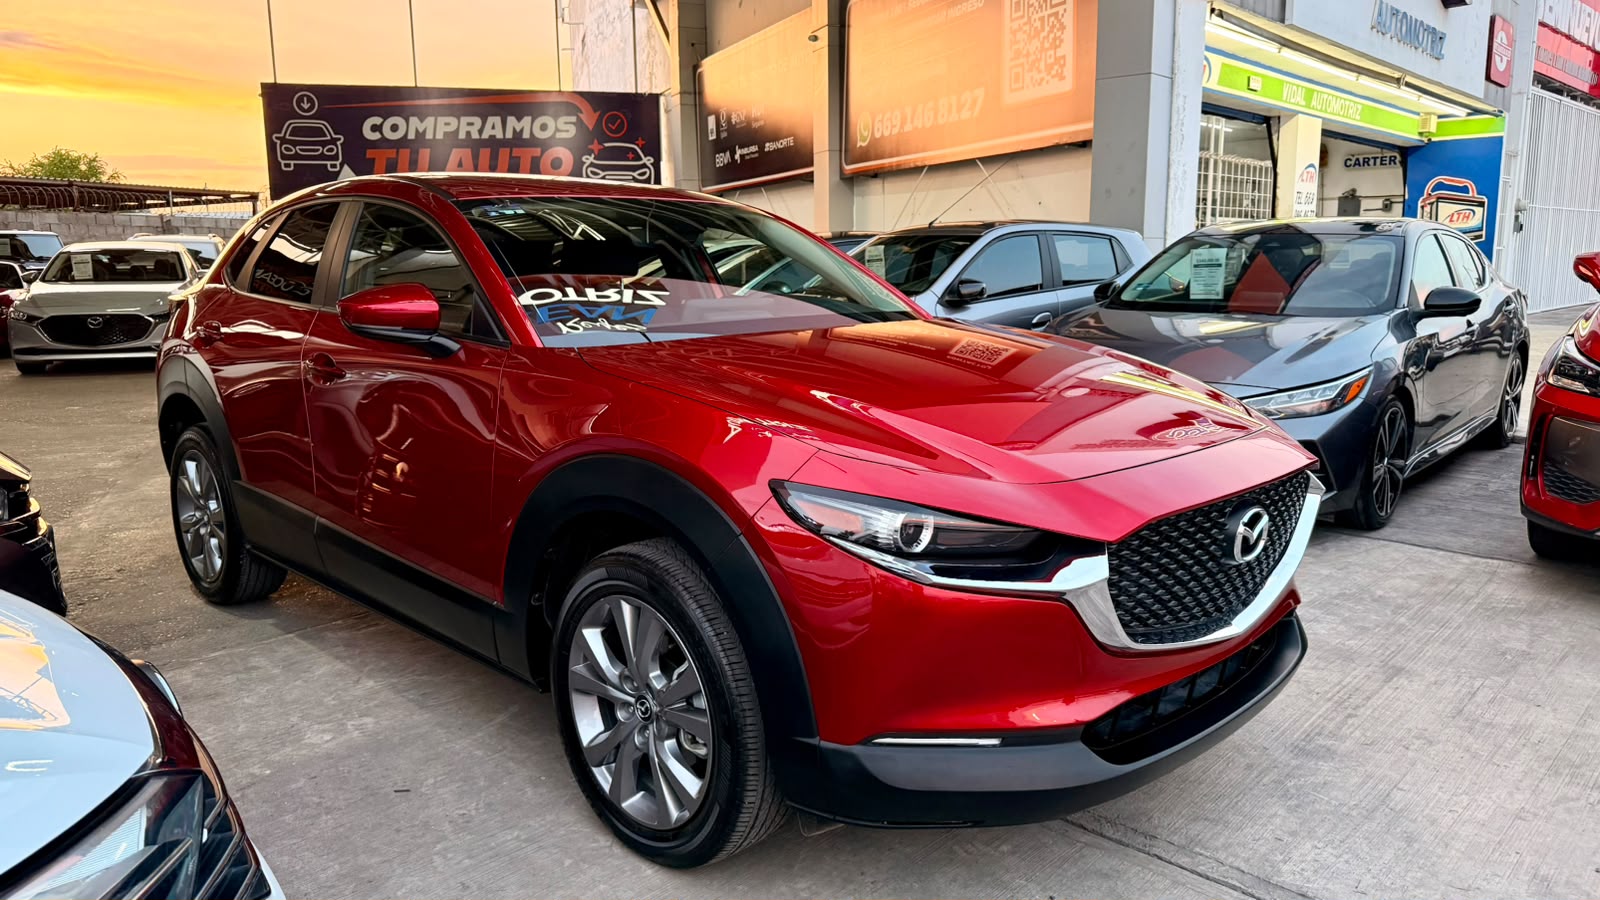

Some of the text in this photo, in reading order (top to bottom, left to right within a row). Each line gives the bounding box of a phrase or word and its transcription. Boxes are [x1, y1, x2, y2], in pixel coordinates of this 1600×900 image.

[1373, 1, 1447, 60] AUTOMOTRIZ
[1282, 82, 1363, 120] VIDAL AUTOMOTRIZ
[362, 115, 577, 140] COMPRAMOS
[769, 137, 795, 151] BANORTE
[366, 146, 574, 176] TU AUTO
[715, 151, 731, 167] BBVA
[1343, 155, 1398, 168] CARTER
[1300, 170, 1316, 183] LTH
[1448, 211, 1472, 223] LTH
